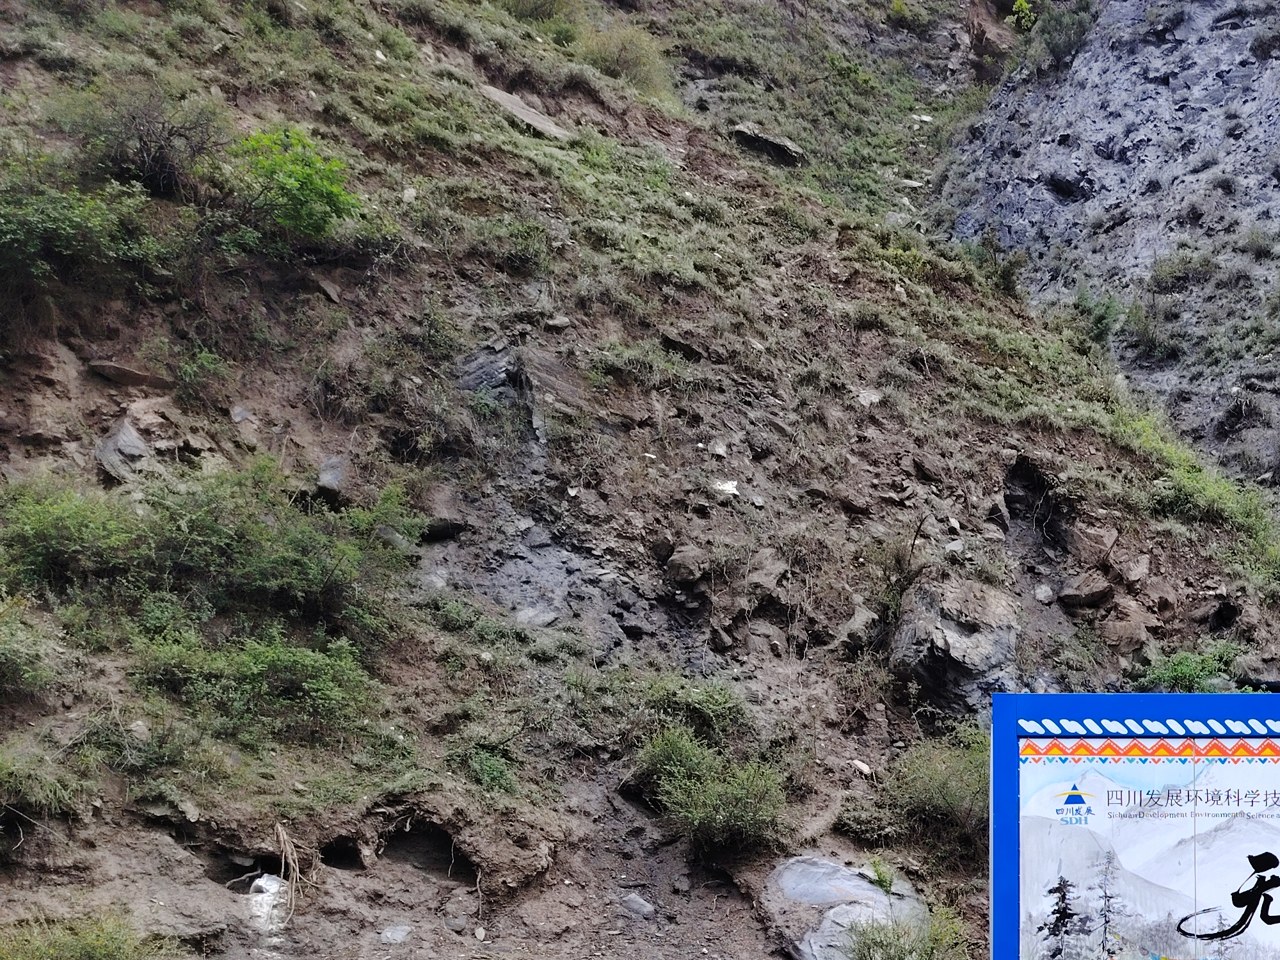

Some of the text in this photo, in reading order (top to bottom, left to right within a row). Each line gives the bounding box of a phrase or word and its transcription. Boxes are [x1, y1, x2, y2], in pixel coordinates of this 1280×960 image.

[1055, 805, 1096, 817] 四川发展
[1059, 816, 1089, 826] SDH
